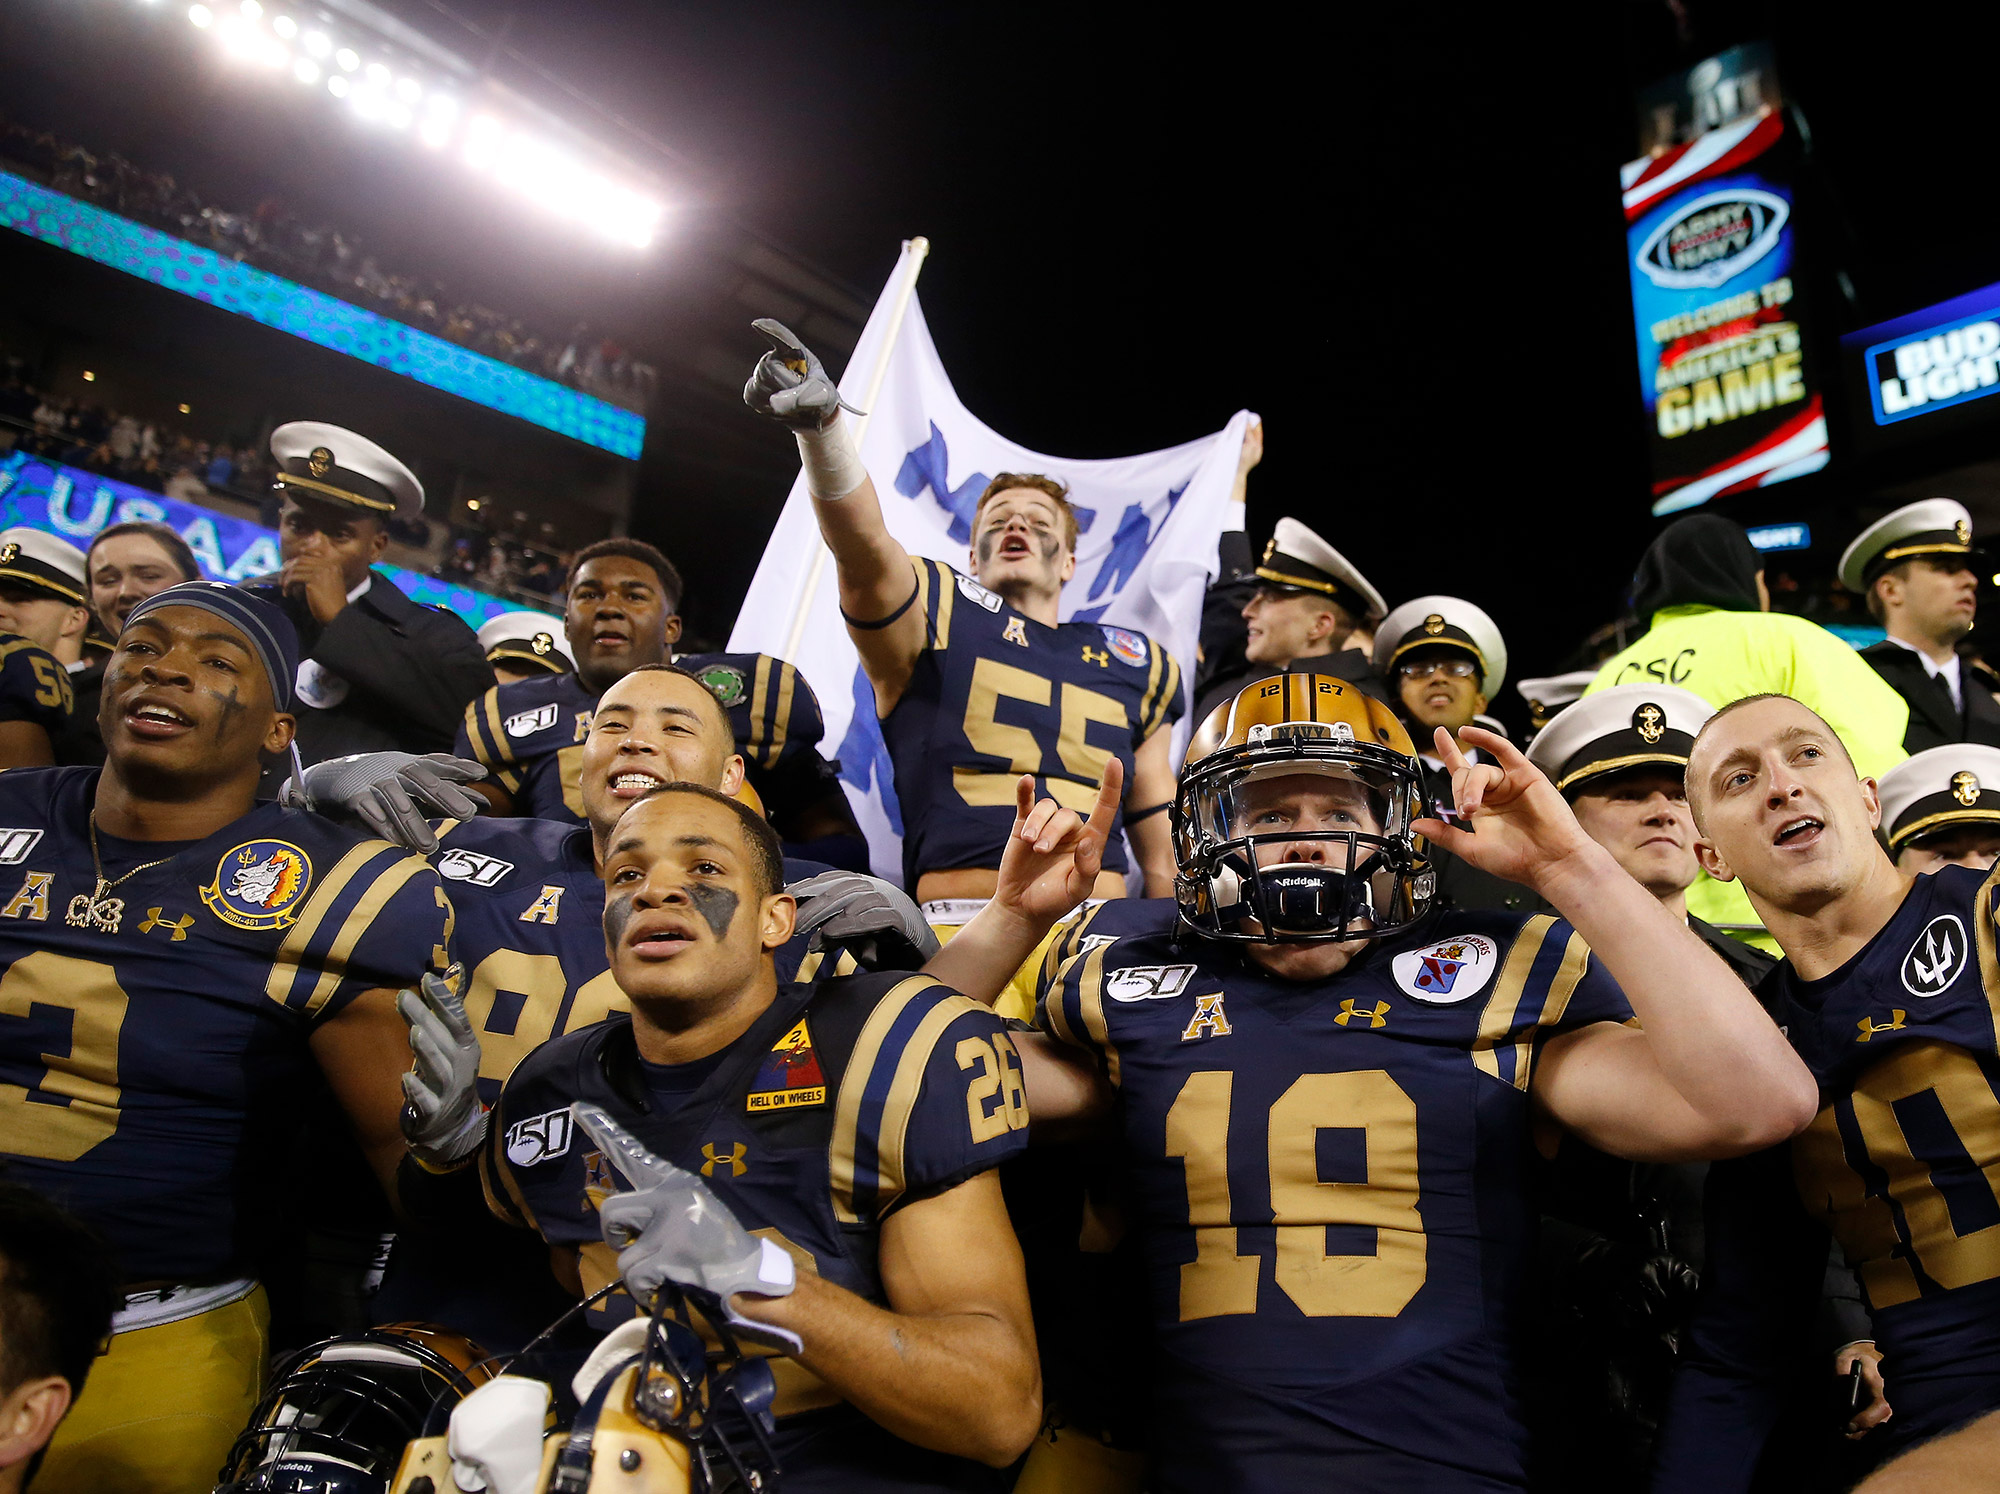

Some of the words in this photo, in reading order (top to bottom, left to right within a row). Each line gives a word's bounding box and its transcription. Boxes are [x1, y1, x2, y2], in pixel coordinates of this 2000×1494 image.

[1894, 320, 2000, 380] BUD
[1657, 348, 1806, 439] GAME
[1260, 684, 1280, 698] 12
[1319, 683, 1344, 696] 27
[503, 703, 559, 738] 150
[953, 656, 1130, 815] 55
[438, 848, 515, 887] 150
[223, 910, 259, 926] HMH-461
[1106, 964, 1198, 1003] 150
[788, 1030, 802, 1044] 2
[750, 1096, 770, 1108] HELL
[773, 1095, 786, 1106] ON
[787, 1090, 822, 1104] WHEELS
[954, 1032, 1030, 1145] 26
[506, 1106, 574, 1167] 150
[1165, 1069, 1429, 1321] 18
